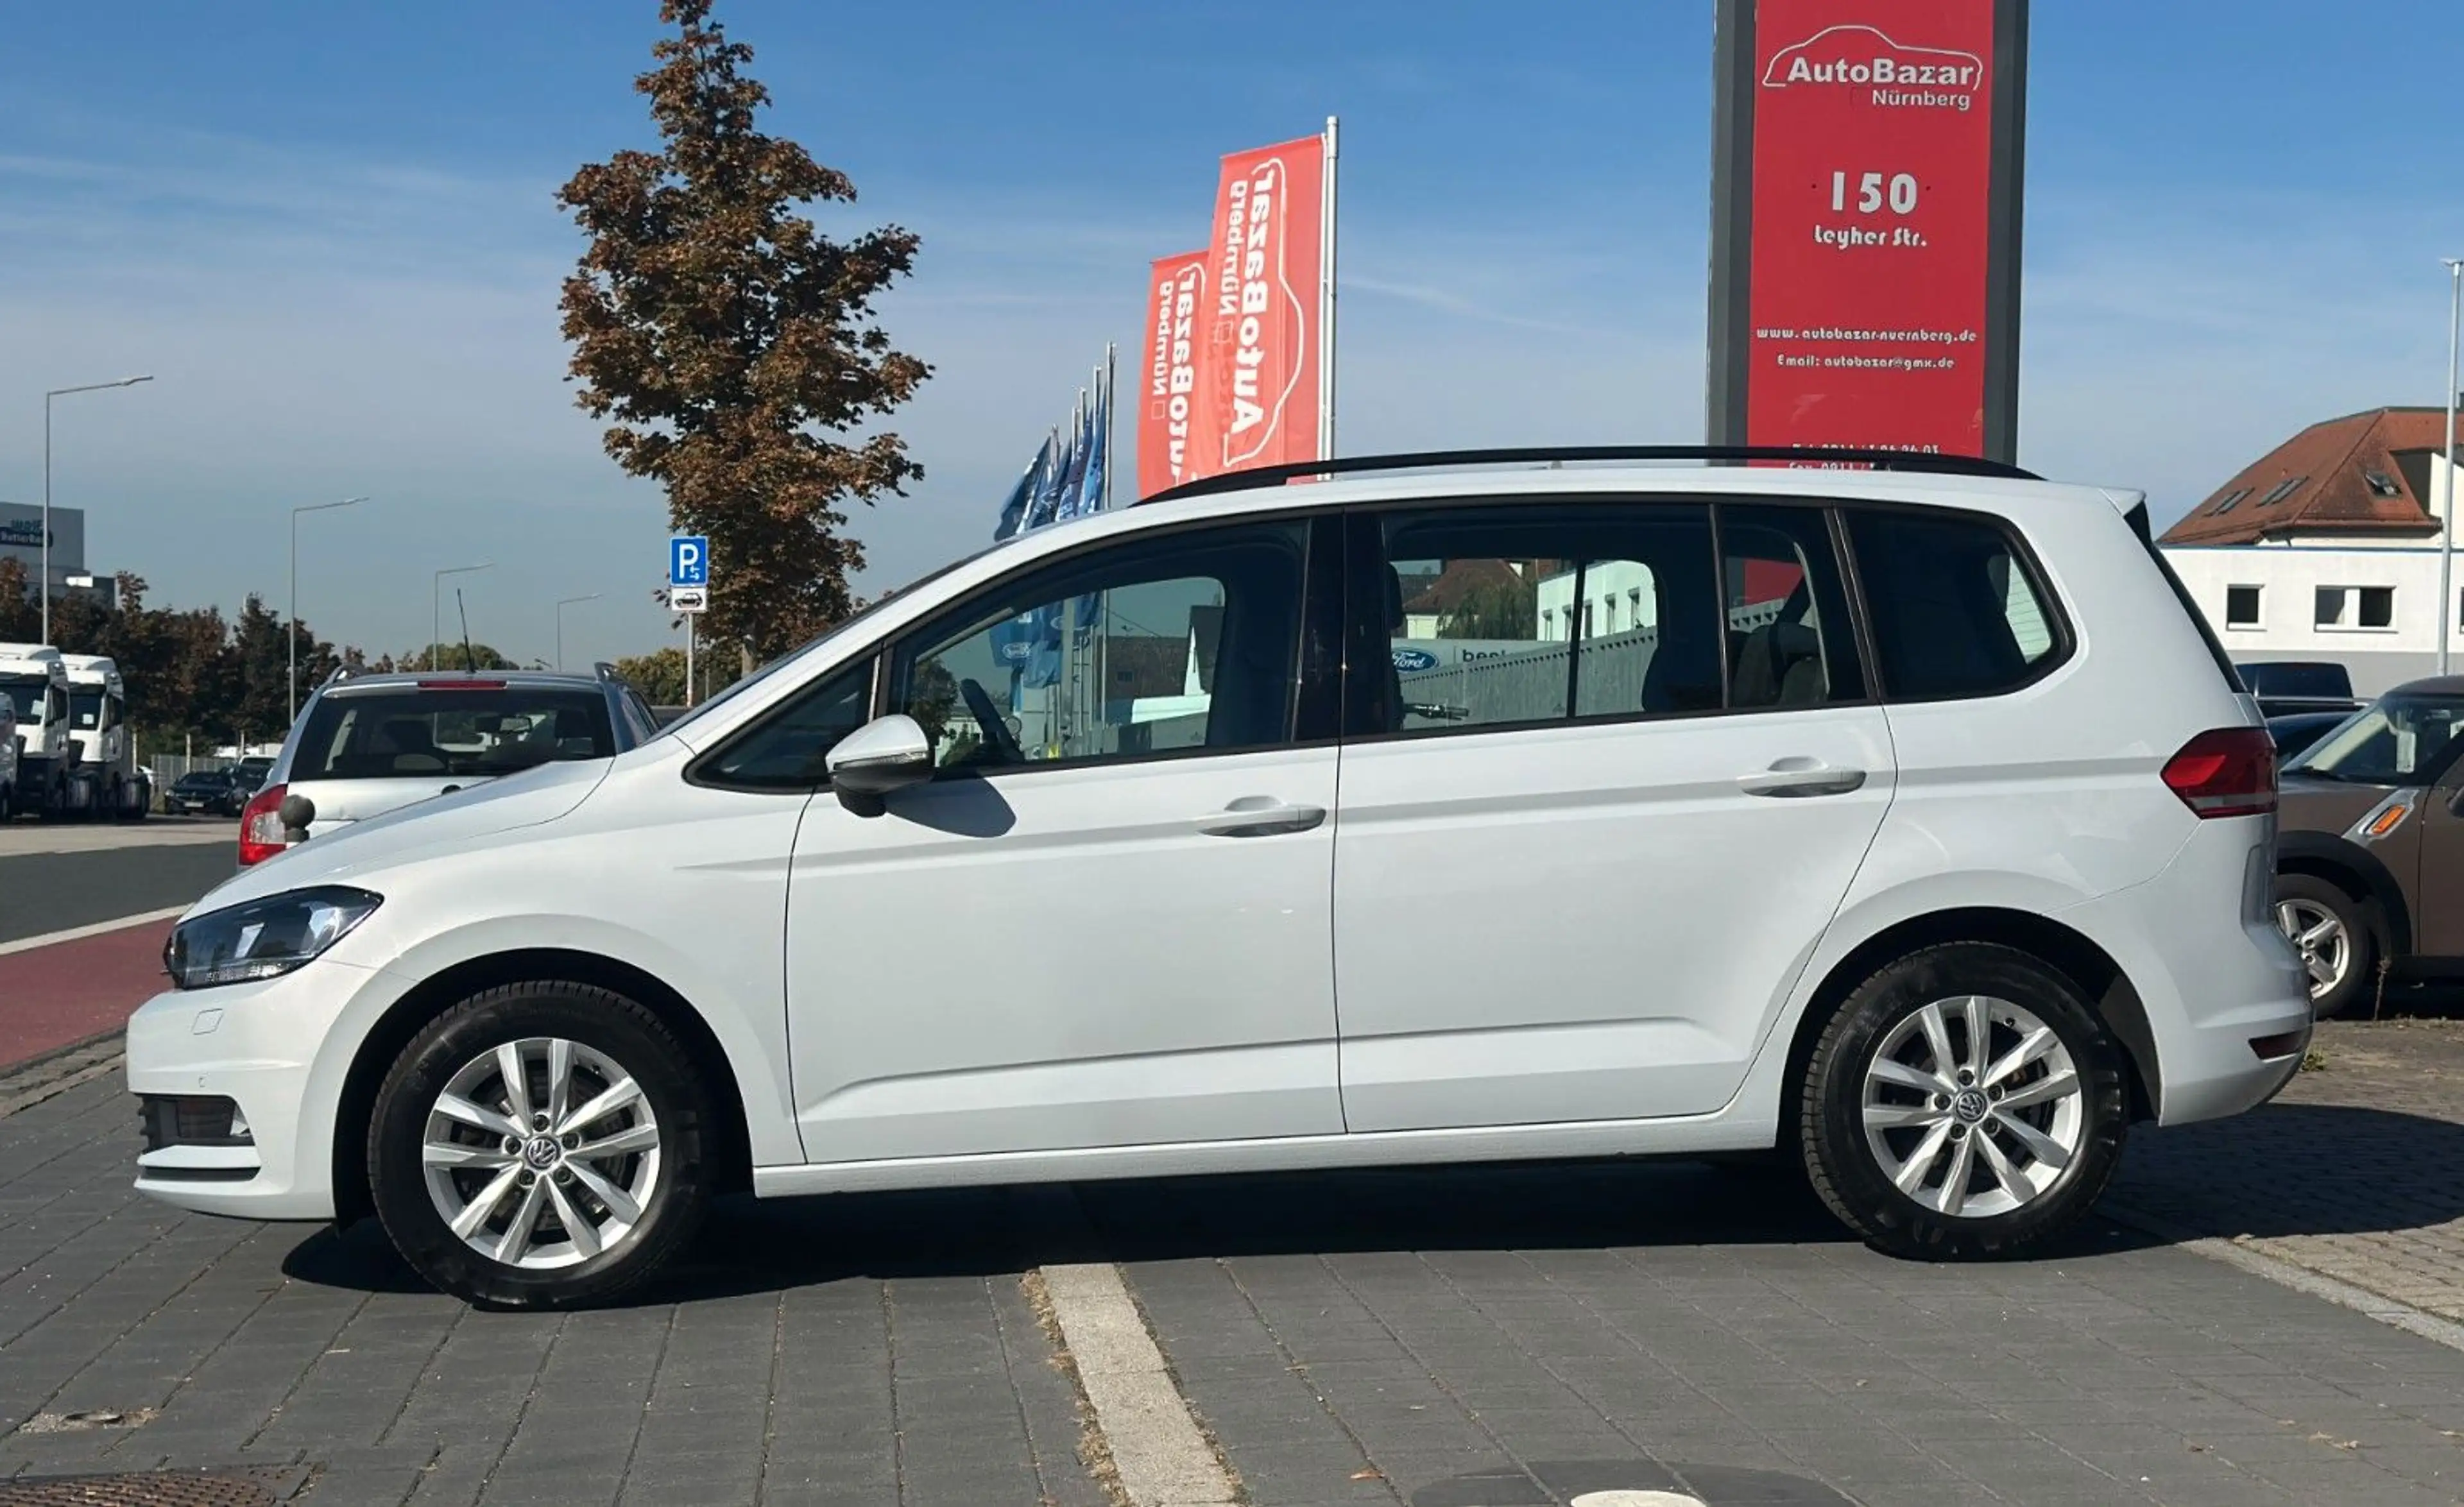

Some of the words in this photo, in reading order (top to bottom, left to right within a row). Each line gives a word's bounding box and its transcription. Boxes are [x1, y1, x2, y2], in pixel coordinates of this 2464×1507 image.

[1788, 57, 1974, 85] AutoBazar
[1872, 89, 1969, 111] Nürnberg
[1833, 171, 1917, 214] 150
[1815, 225, 1887, 250] Leyher
[1893, 227, 1928, 246] Str.
[1777, 353, 1820, 367] Email:
[1825, 355, 1955, 371] autobazar@gmx.de
[680, 543, 699, 579] P
[1392, 651, 1426, 667] Ford
